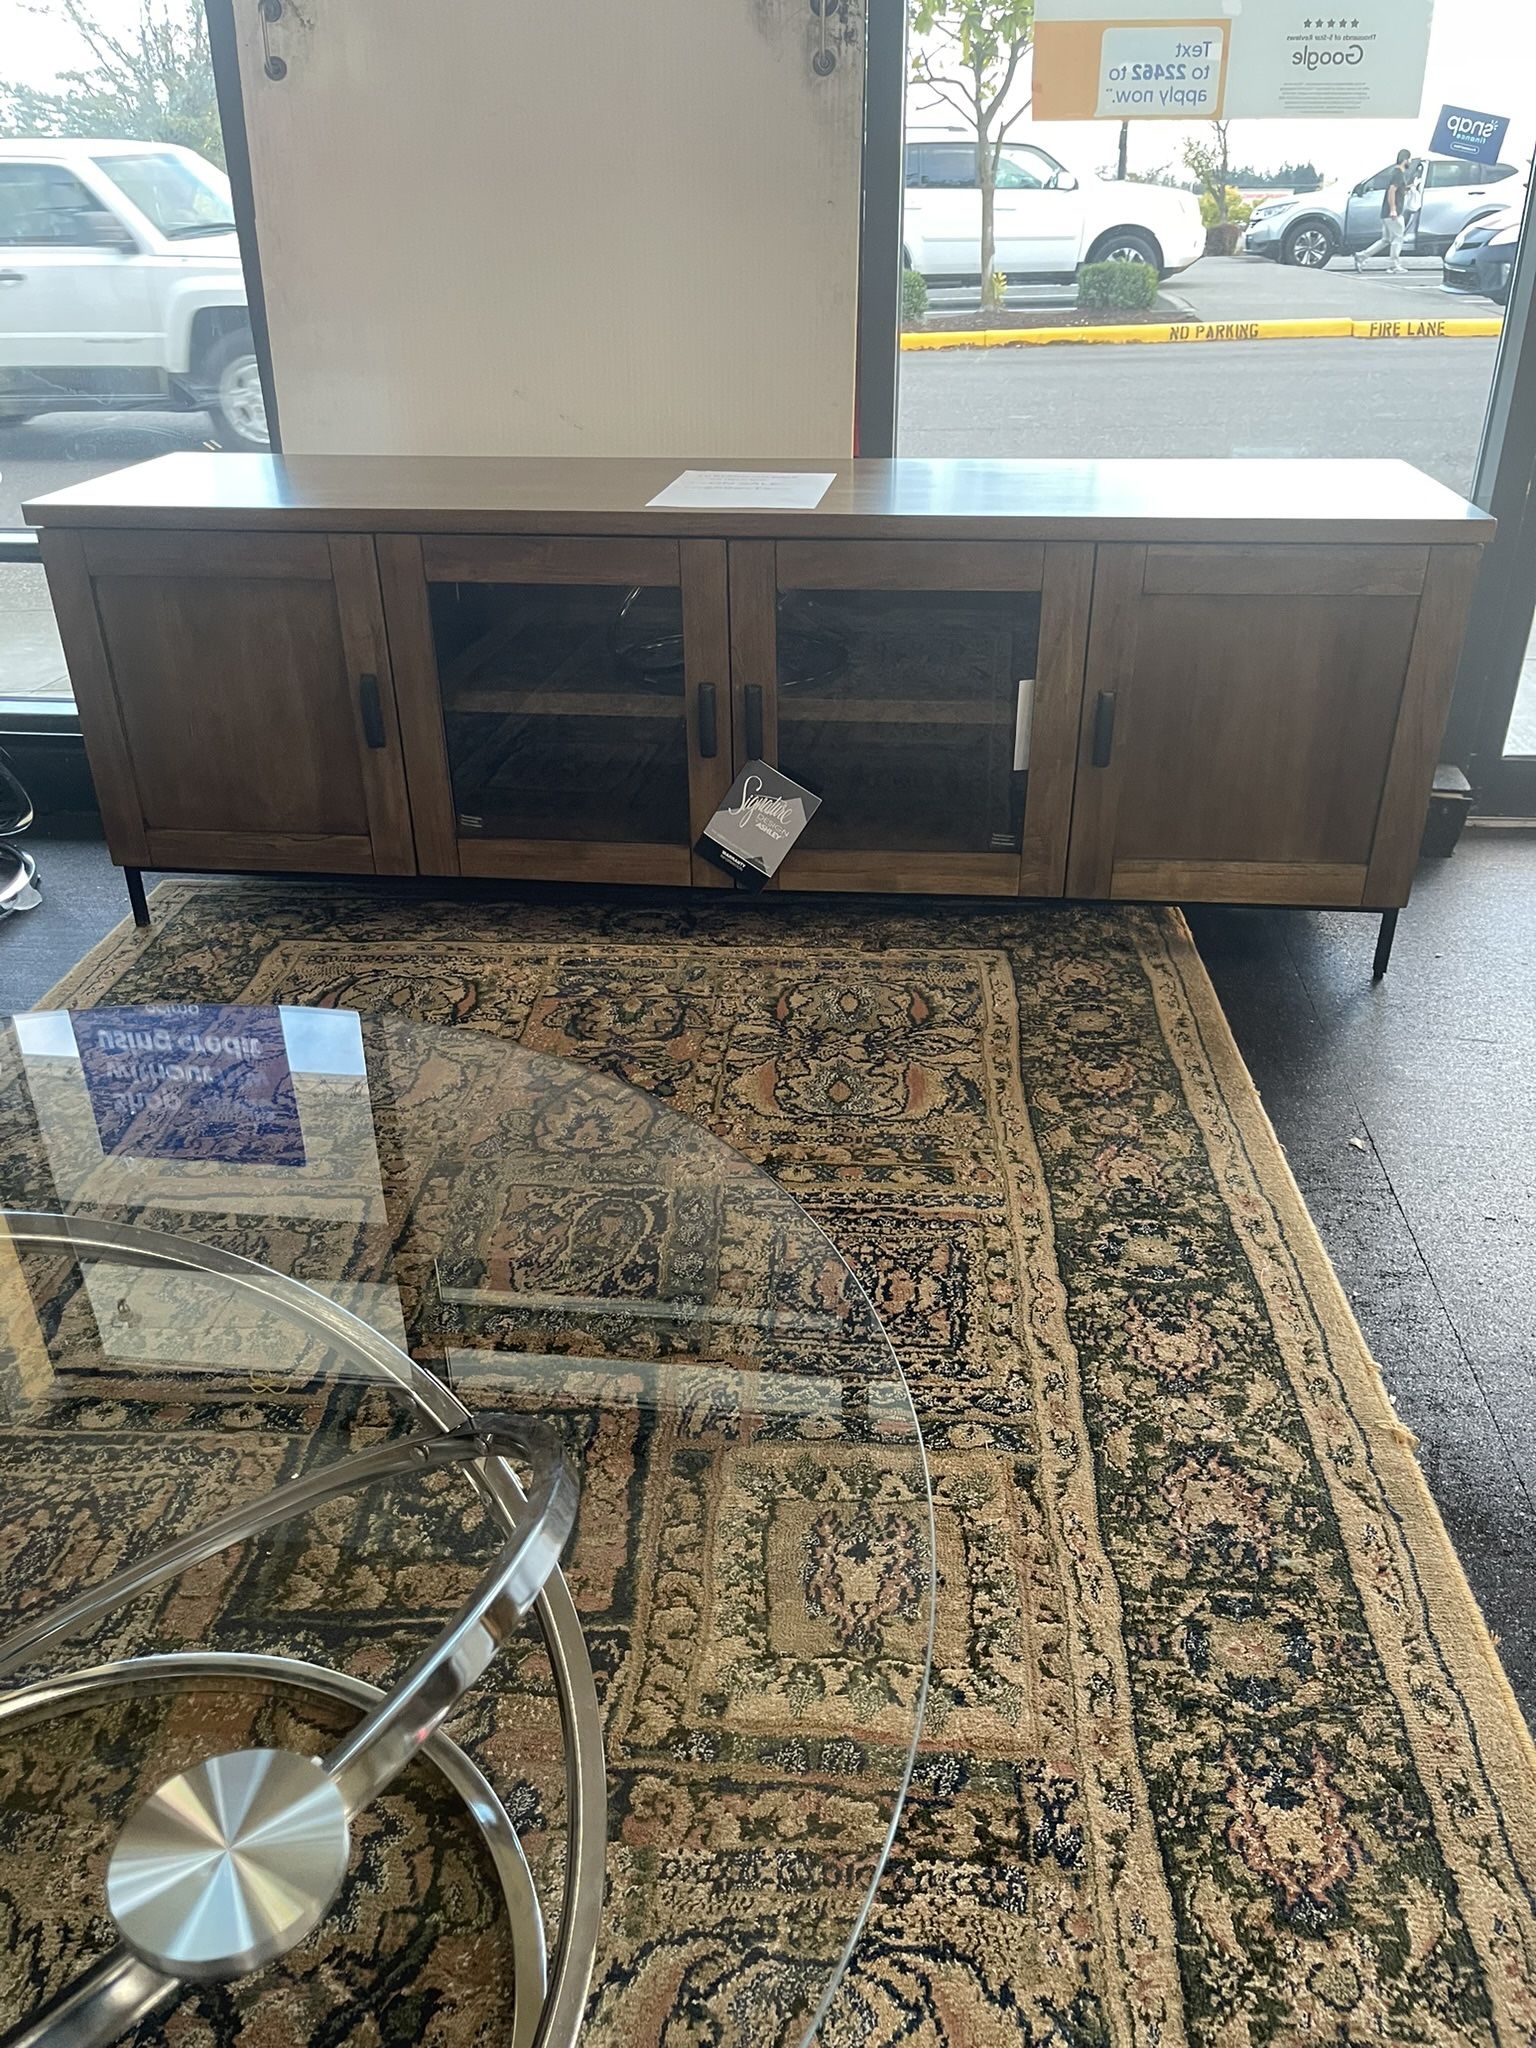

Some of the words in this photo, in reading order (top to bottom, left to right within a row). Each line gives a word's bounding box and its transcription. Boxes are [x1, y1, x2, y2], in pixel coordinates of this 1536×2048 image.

[1169, 326, 1189, 341] NO
[1195, 323, 1259, 340] PARKING
[1369, 321, 1400, 338] FIRE
[1407, 321, 1446, 337] LANE
[728, 775, 793, 828] Signature
[755, 822, 782, 840] ASHLEY
[757, 813, 790, 837] DESIGN
